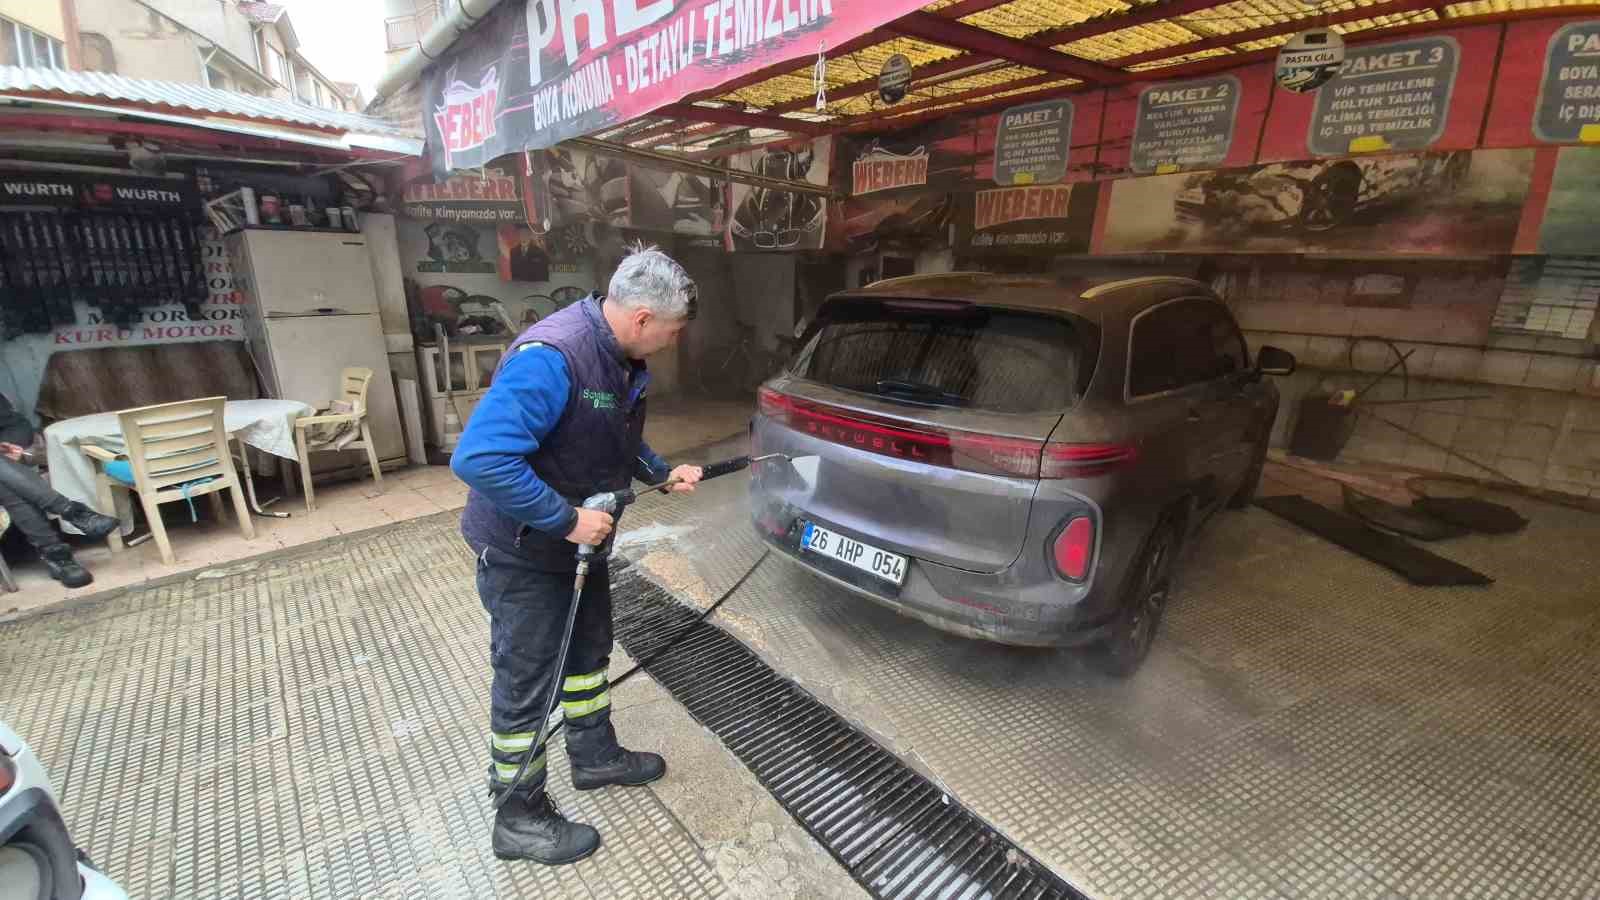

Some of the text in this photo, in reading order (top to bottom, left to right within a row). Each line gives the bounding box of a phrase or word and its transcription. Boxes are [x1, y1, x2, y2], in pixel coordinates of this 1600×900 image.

[533, 84, 561, 131] BOYA
[561, 56, 614, 120] KORUMA
[624, 9, 696, 94] DETAYLI
[1285, 56, 1312, 64] PASTA
[1338, 47, 1444, 74] PAKET 3
[1148, 83, 1230, 105] PAKET 2
[1006, 107, 1064, 126] PAKET 1
[143, 323, 236, 340] MOTOR
[811, 528, 902, 580] 26 AHP 054
